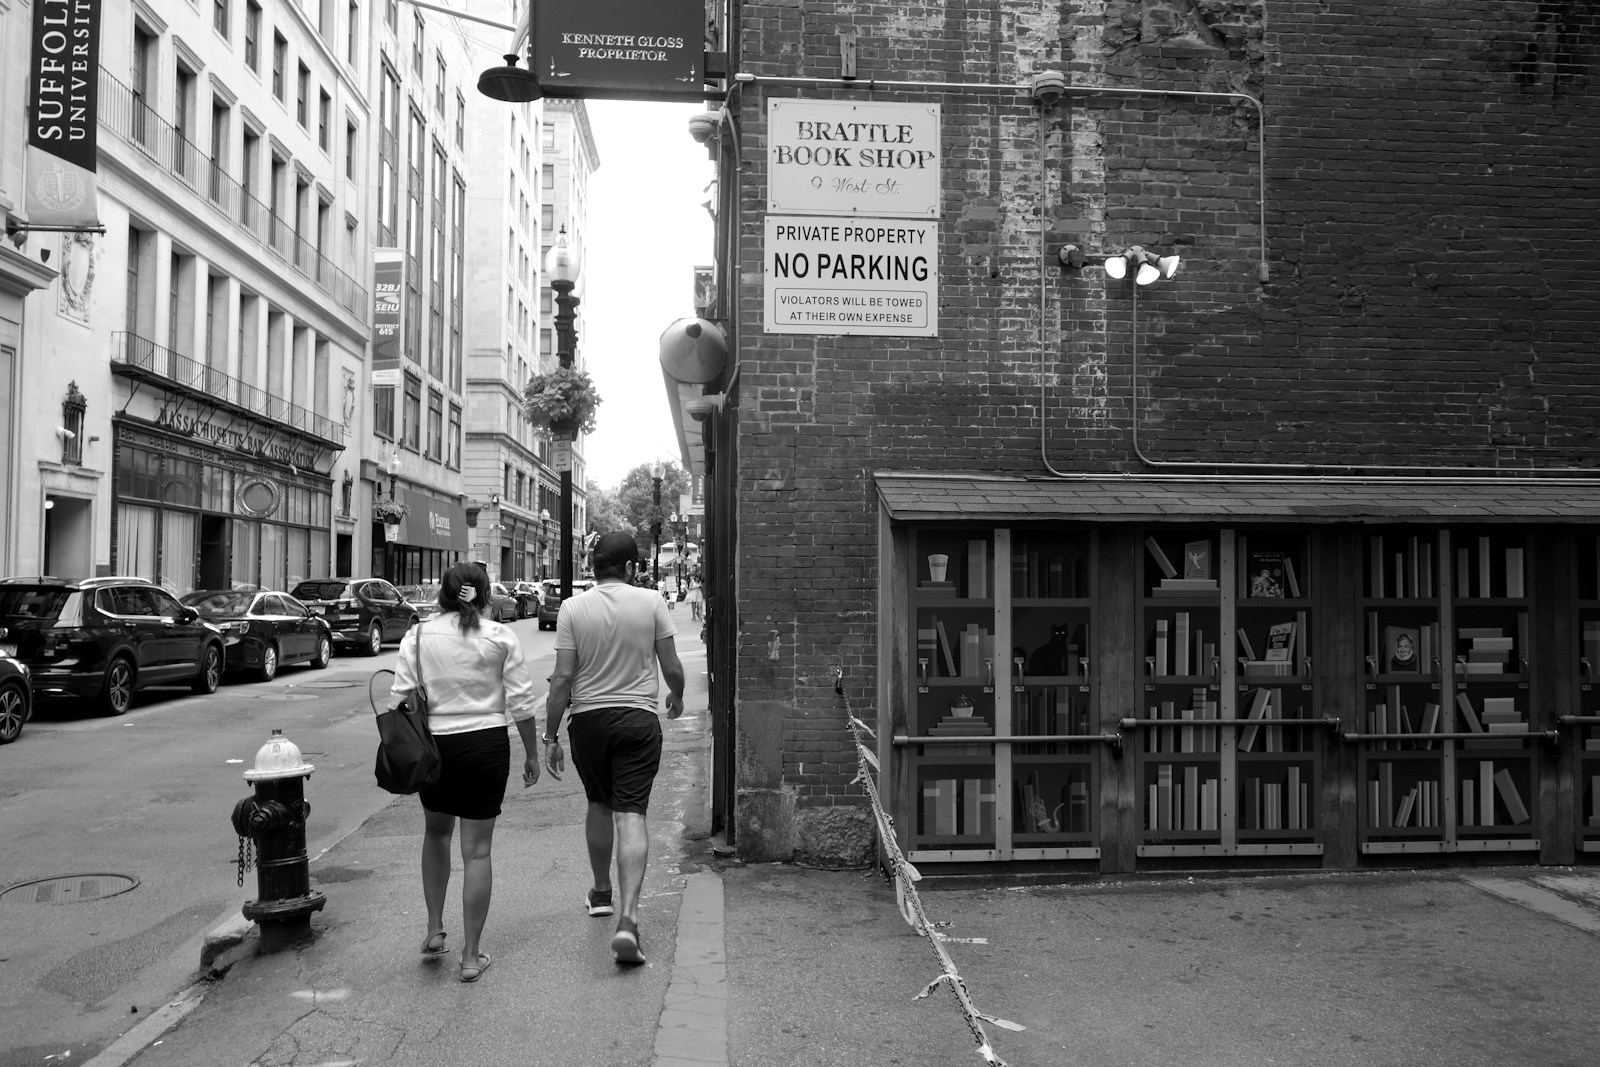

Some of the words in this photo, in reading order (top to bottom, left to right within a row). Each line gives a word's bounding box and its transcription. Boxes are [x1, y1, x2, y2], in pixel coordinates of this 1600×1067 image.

[561, 32, 635, 46] KENNETH
[637, 35, 684, 49] GLOSS
[578, 47, 668, 62] PROPRIETOR
[37, 0, 69, 140] SUFFOL
[69, 0, 91, 141] UNIVERSIT
[795, 121, 914, 144] BRATTLE
[775, 145, 853, 167] BOOK
[859, 148, 934, 169] SHOP
[811, 175, 823, 190] 9
[831, 176, 870, 193] West
[875, 177, 903, 195] St.
[776, 225, 840, 241] PRIVATE
[844, 227, 926, 244] PROPERTY
[774, 252, 809, 278] NO
[817, 253, 928, 282] PARKING
[375, 283, 400, 292] 32BJ
[375, 303, 400, 311] SEIU
[780, 295, 840, 306] VIOLATORS
[842, 297, 867, 306] WILL
[869, 298, 883, 307] BE
[886, 298, 923, 308] TOWED
[790, 311, 803, 321] AT
[805, 312, 836, 321] THEIR
[838, 312, 863, 322] OWN
[865, 313, 913, 323] EXPENSE
[159, 407, 243, 446] MASSACHUSETTS
[247, 436, 263, 454] BAR
[268, 443, 314, 467] ASSOCIATION
